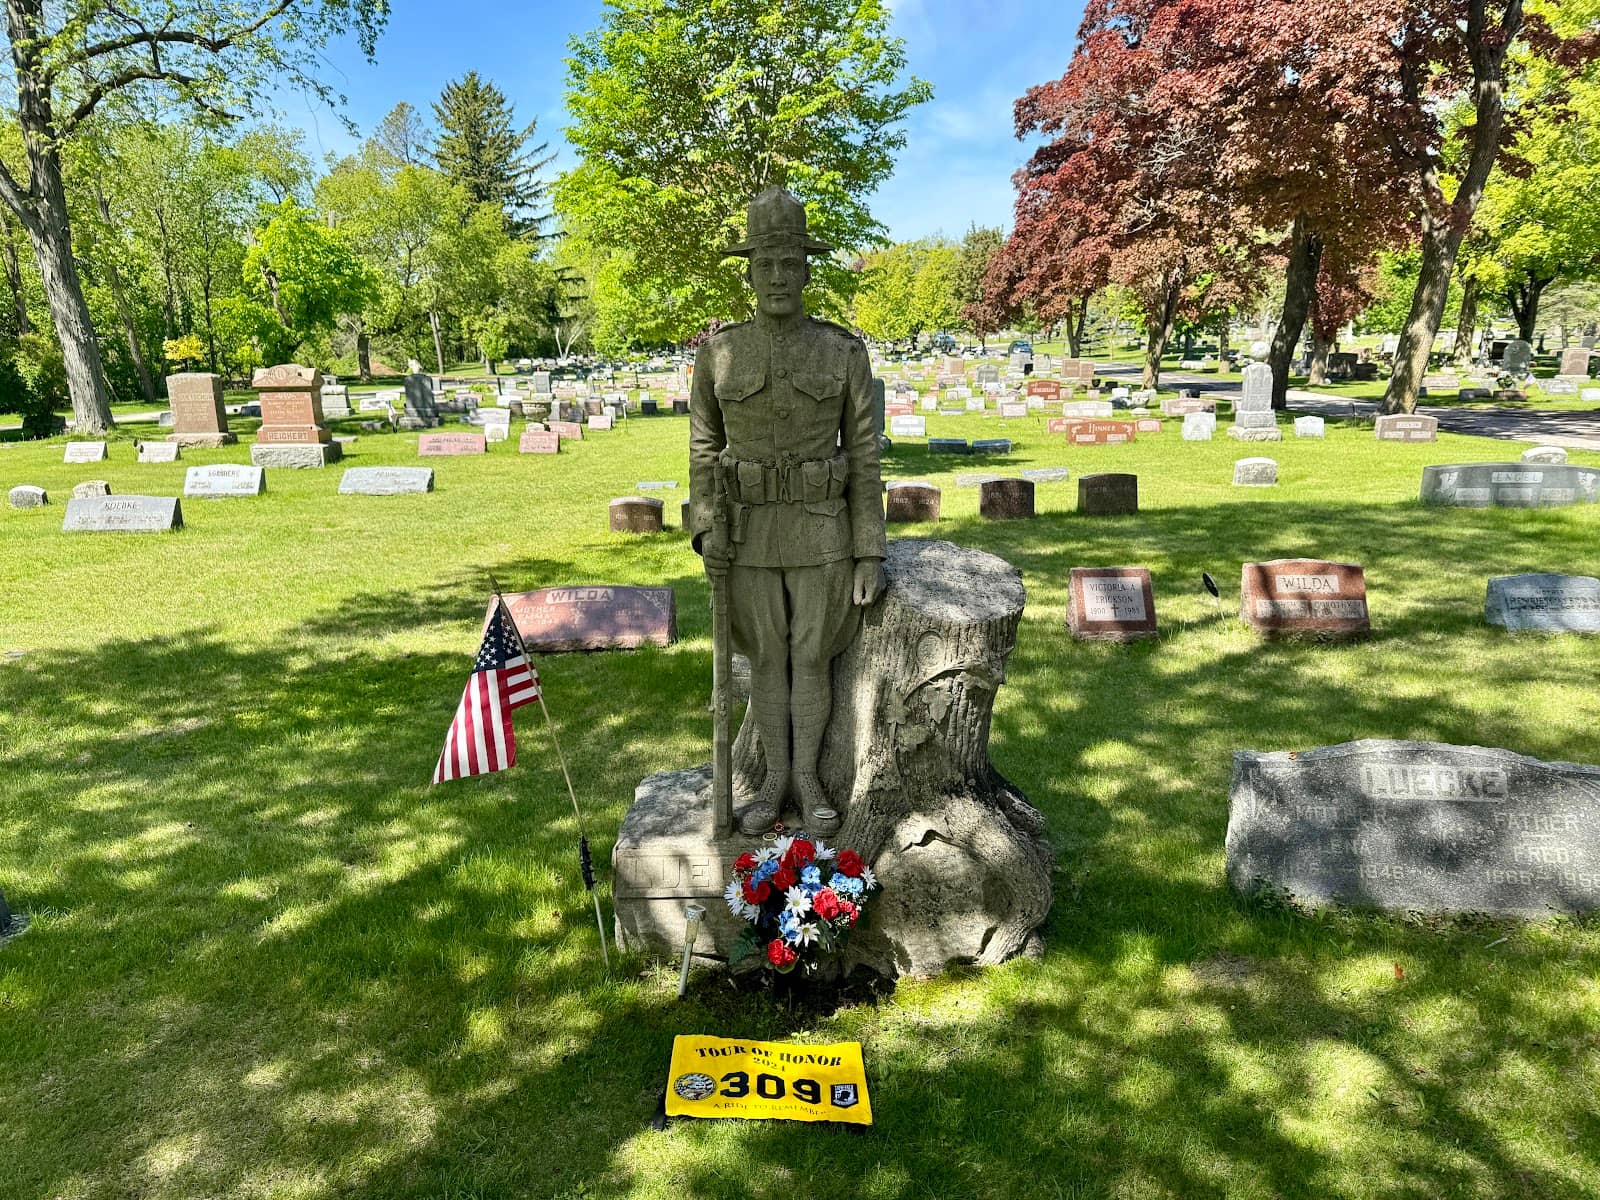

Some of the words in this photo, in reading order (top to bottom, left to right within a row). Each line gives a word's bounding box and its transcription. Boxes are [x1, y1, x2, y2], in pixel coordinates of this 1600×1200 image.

[1089, 583, 1126, 592] VICTORIA
[1280, 577, 1332, 590] WILDA
[551, 589, 610, 602] WILDA
[1095, 595, 1133, 604] ERICKSON
[1365, 767, 1503, 798] LUECKE
[1493, 810, 1580, 831] FATHER
[1513, 846, 1570, 864] FRED
[696, 1045, 747, 1058] TOUR
[751, 1047, 773, 1058] OF
[779, 1052, 842, 1067] HONOR
[719, 1071, 822, 1105] 309
